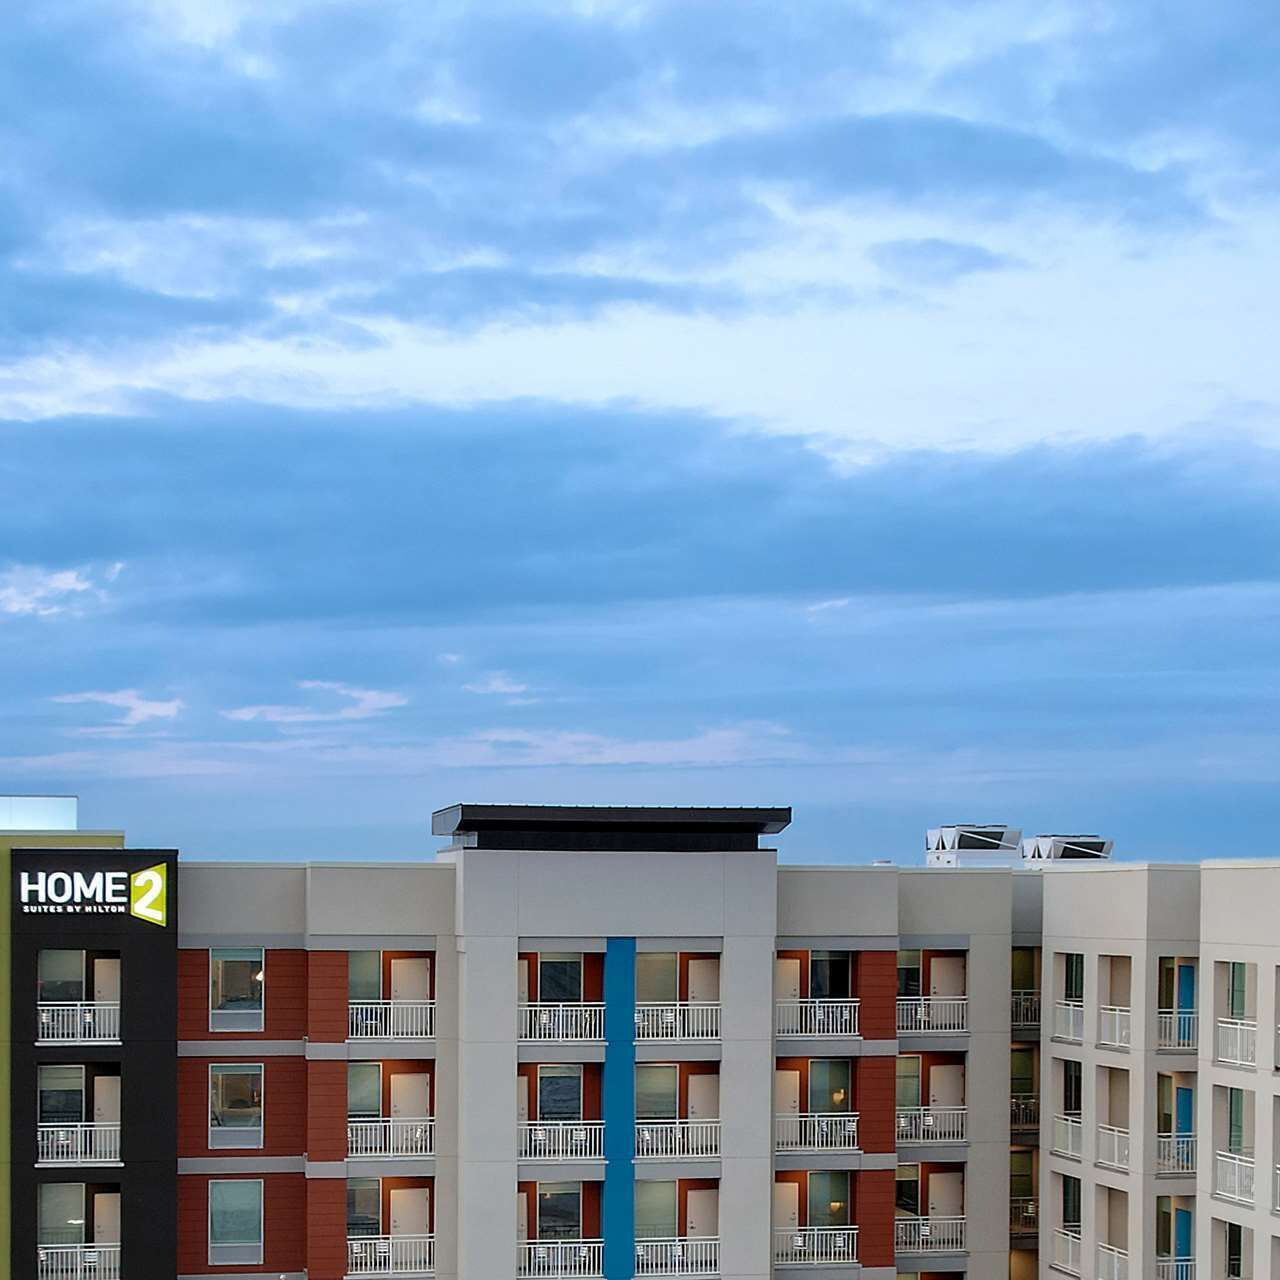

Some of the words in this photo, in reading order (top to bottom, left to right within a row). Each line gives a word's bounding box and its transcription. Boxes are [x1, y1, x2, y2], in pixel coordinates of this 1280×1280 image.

[23, 905, 63, 913] SUITES
[67, 905, 81, 913] BY
[85, 905, 126, 913] HILTON
